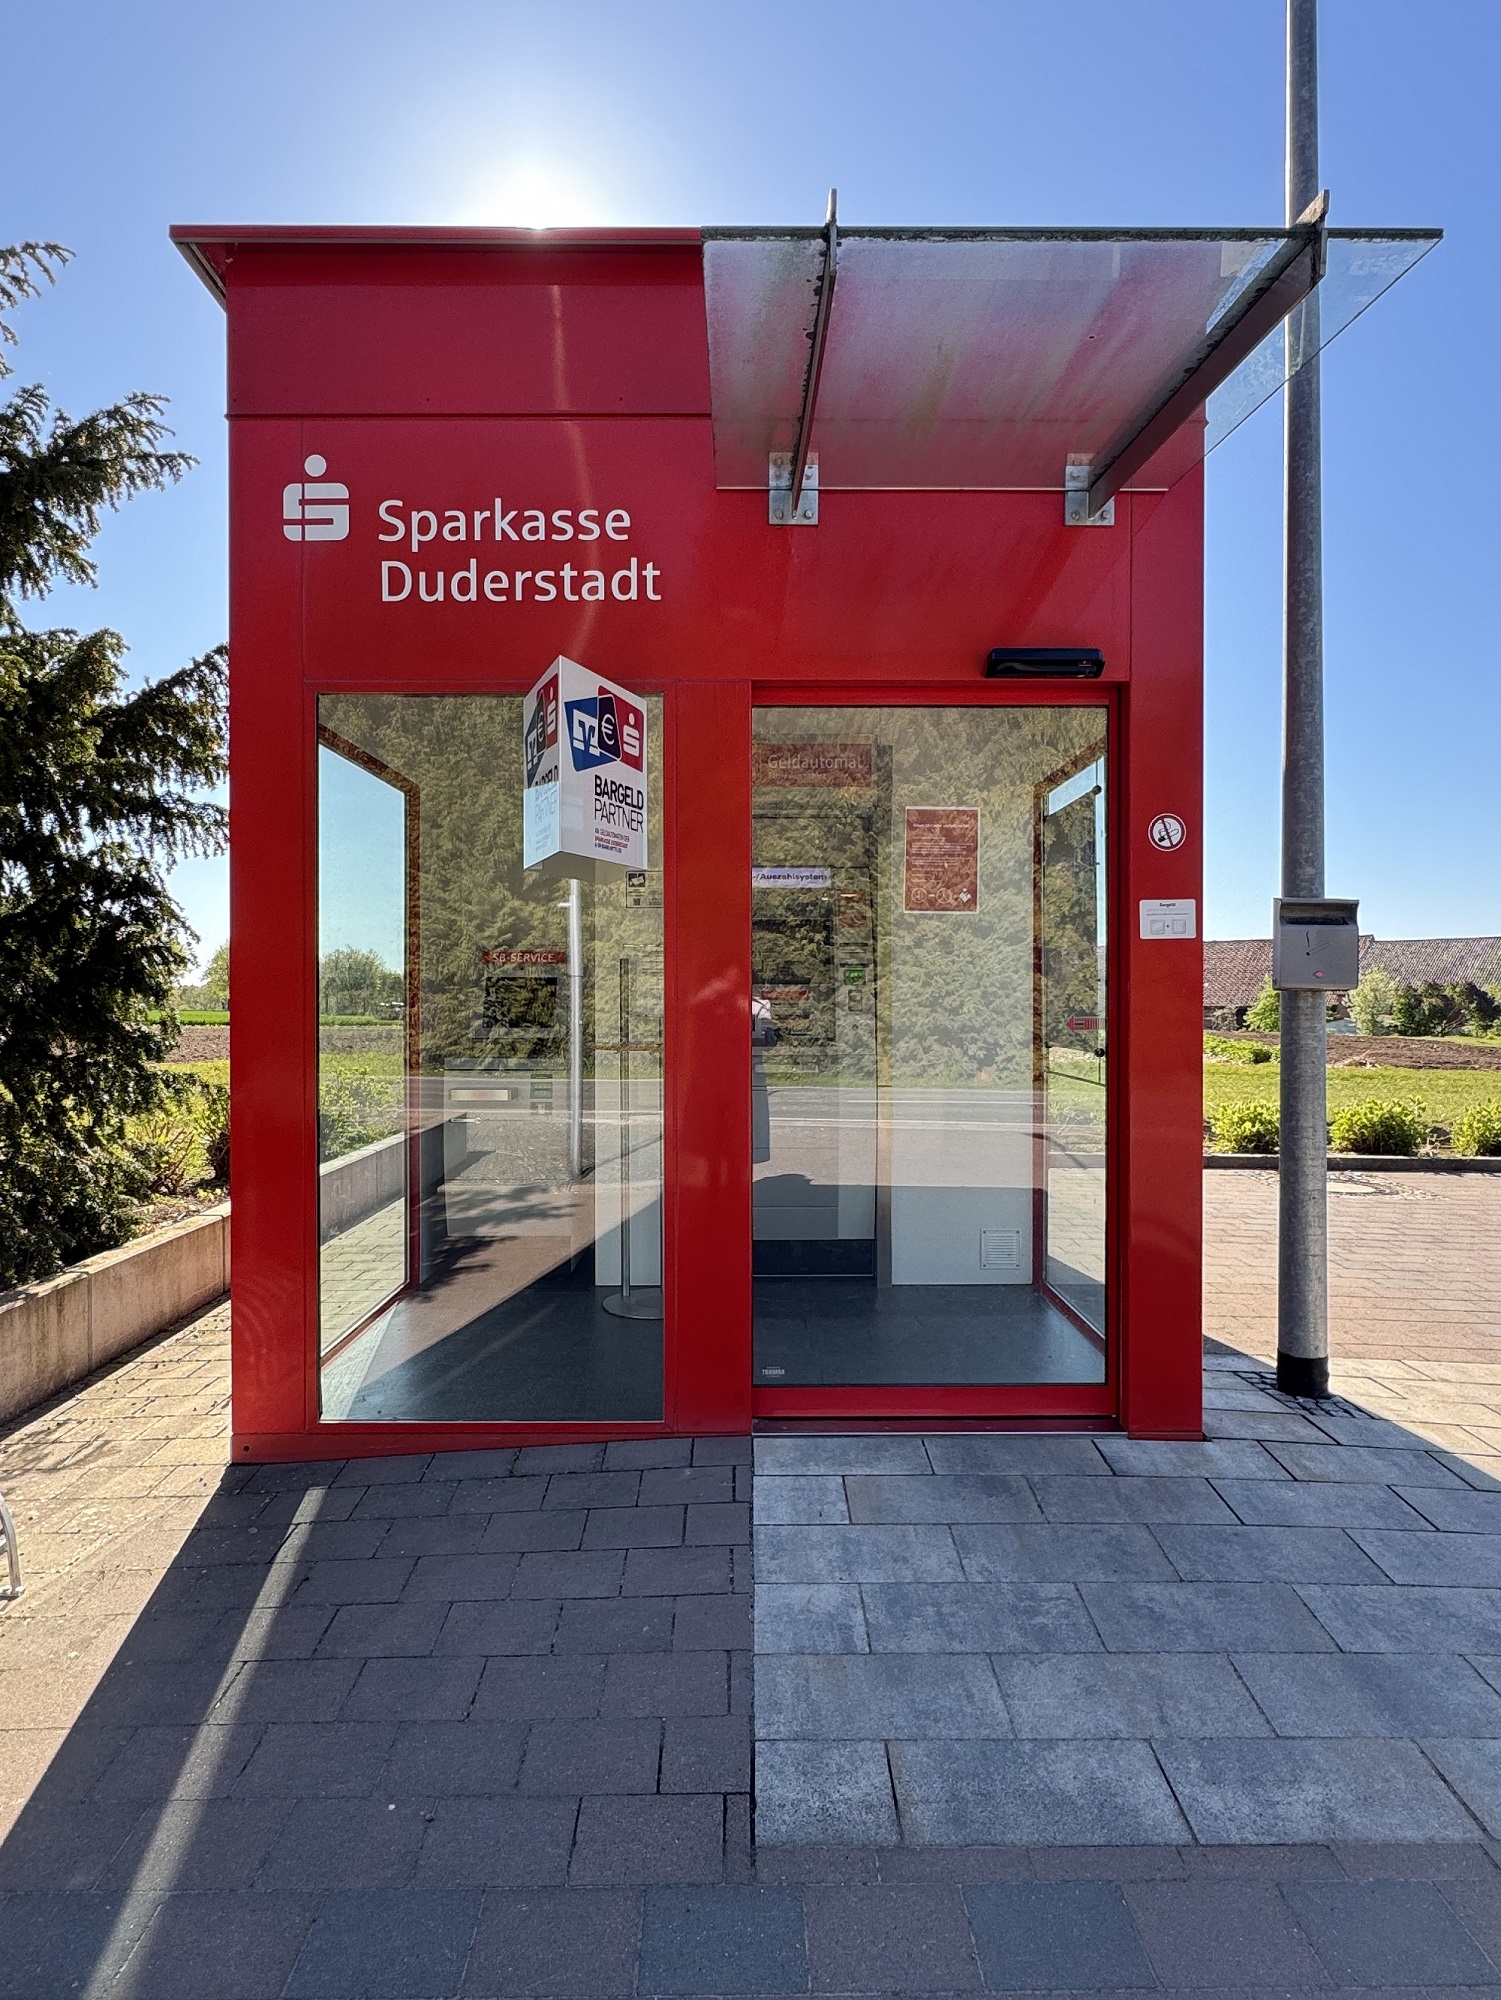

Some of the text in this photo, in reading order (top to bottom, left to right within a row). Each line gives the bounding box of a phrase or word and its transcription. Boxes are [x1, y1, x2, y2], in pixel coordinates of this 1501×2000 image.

[378, 498, 631, 552] Sparkasse
[381, 557, 662, 601] Duderstadt
[767, 754, 863, 769] Geldautomat
[594, 774, 644, 810] BARGELD
[594, 798, 644, 833] PARTNER
[492, 953, 556, 963] SB-SERVICE
